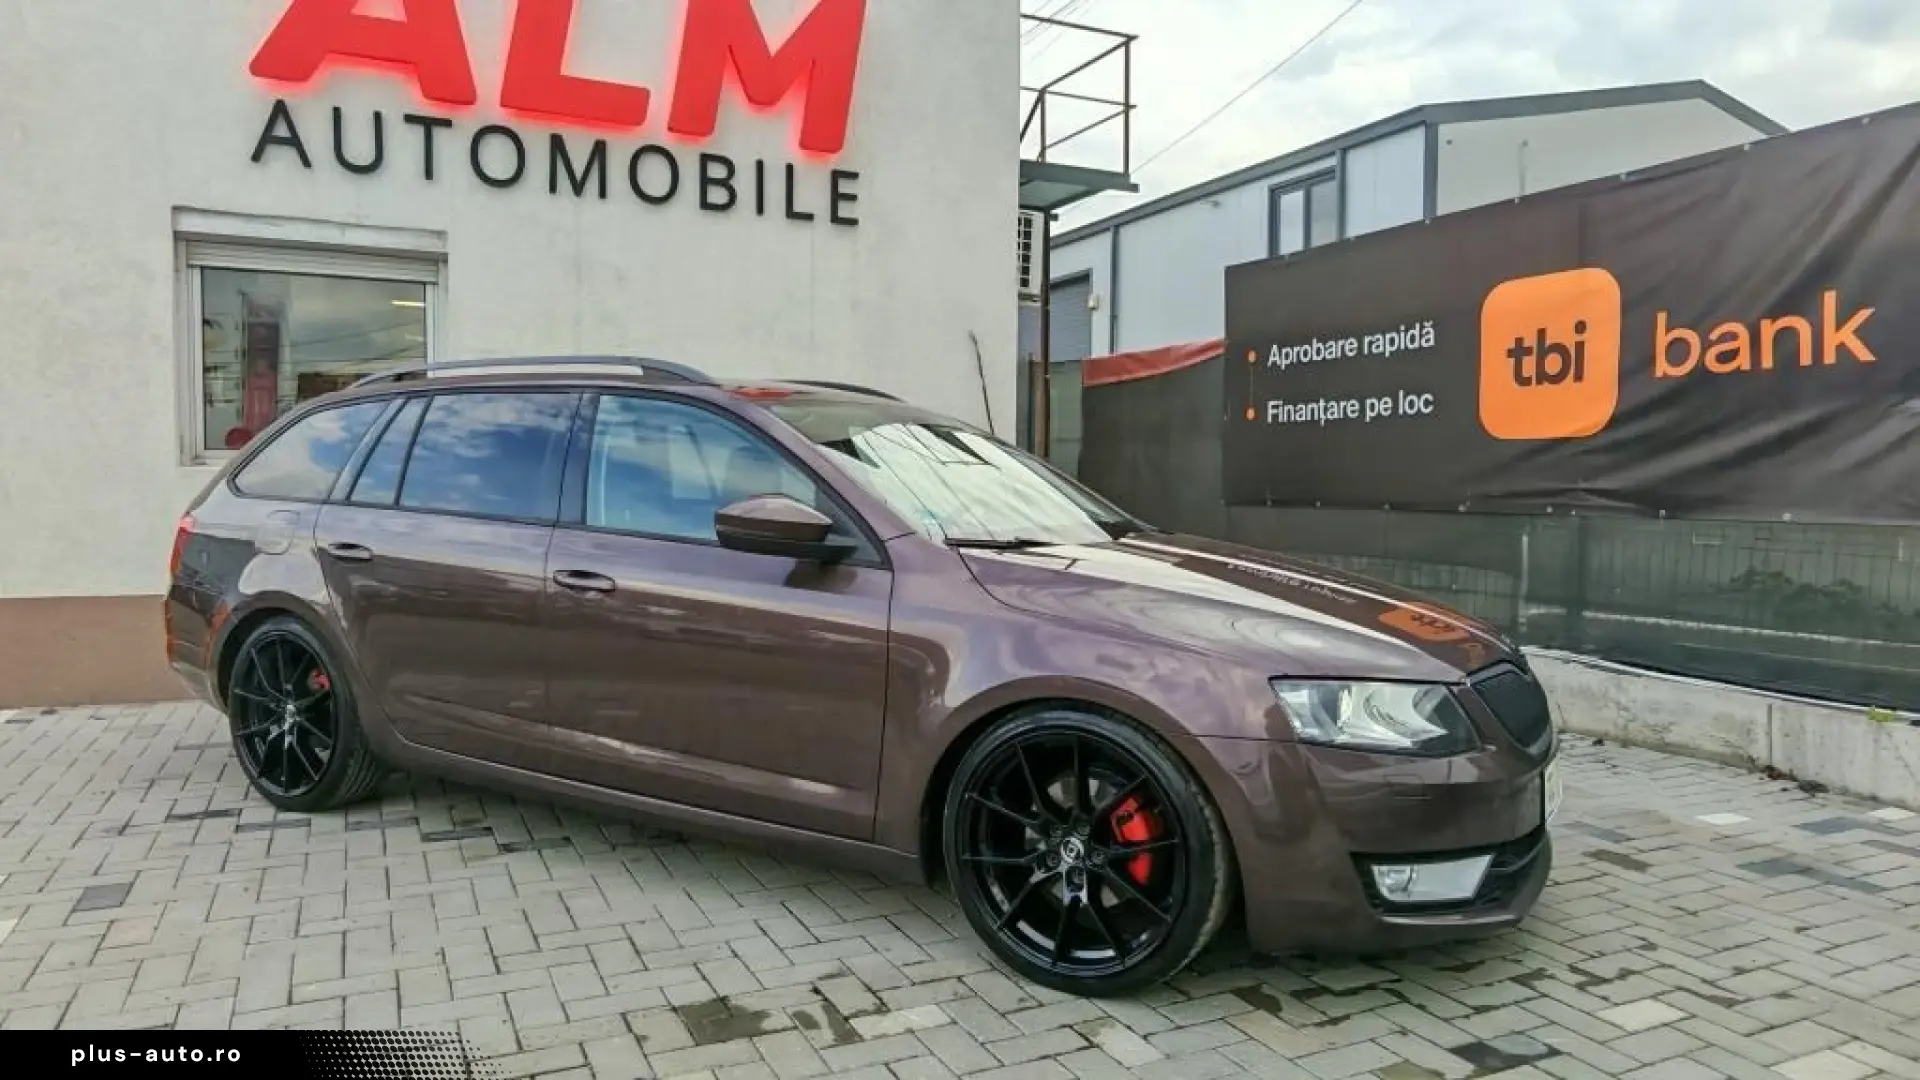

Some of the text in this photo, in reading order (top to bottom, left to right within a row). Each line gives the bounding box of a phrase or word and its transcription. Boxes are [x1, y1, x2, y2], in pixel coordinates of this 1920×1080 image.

[249, 0, 866, 154] ALM
[250, 97, 860, 226] AUTOMOBILE
[1267, 320, 1436, 370] Aprobare rapidă
[1507, 290, 1875, 387] tbi bank
[1266, 389, 1434, 427] Finanțare pe loc
